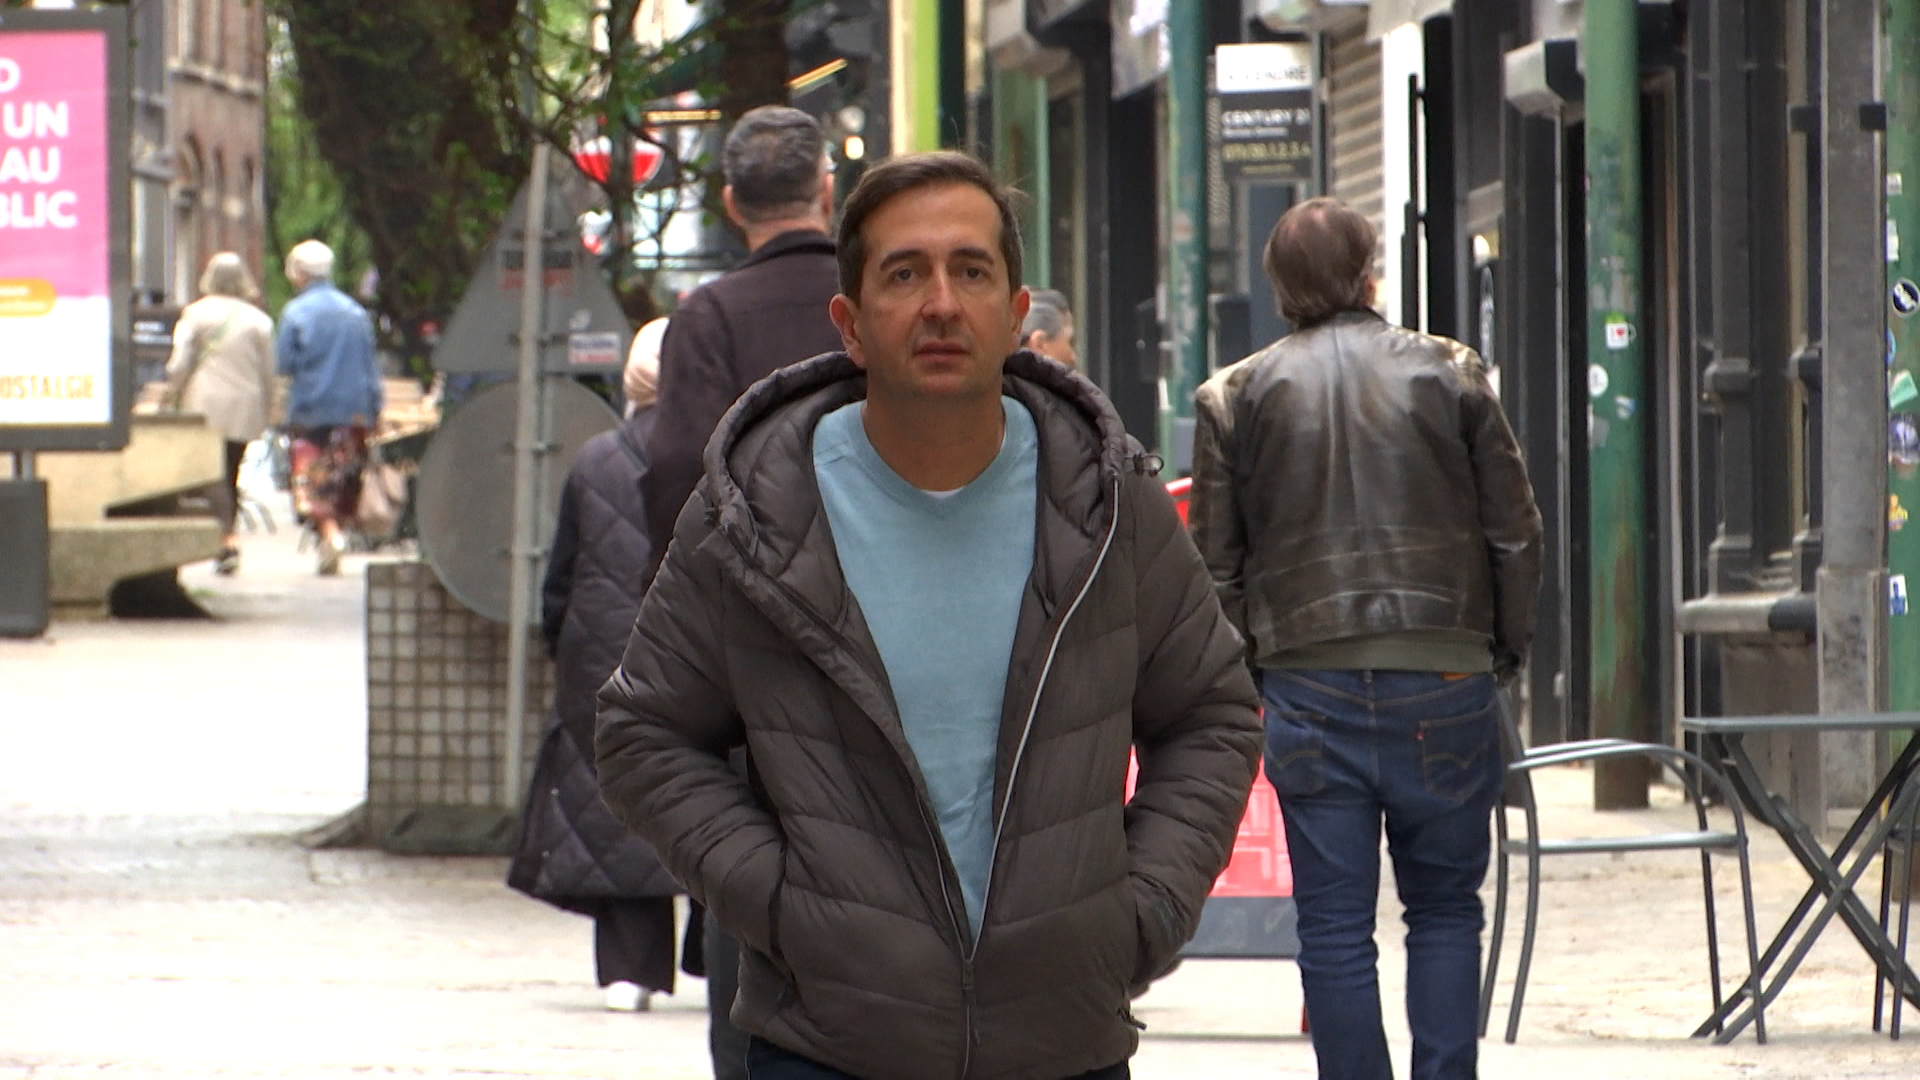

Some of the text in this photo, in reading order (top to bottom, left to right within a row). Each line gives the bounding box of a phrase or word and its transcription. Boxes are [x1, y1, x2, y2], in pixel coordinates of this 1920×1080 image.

[3, 101, 69, 140] UN
[1222, 109, 1291, 127] CENTURY
[0, 146, 61, 184] AU
